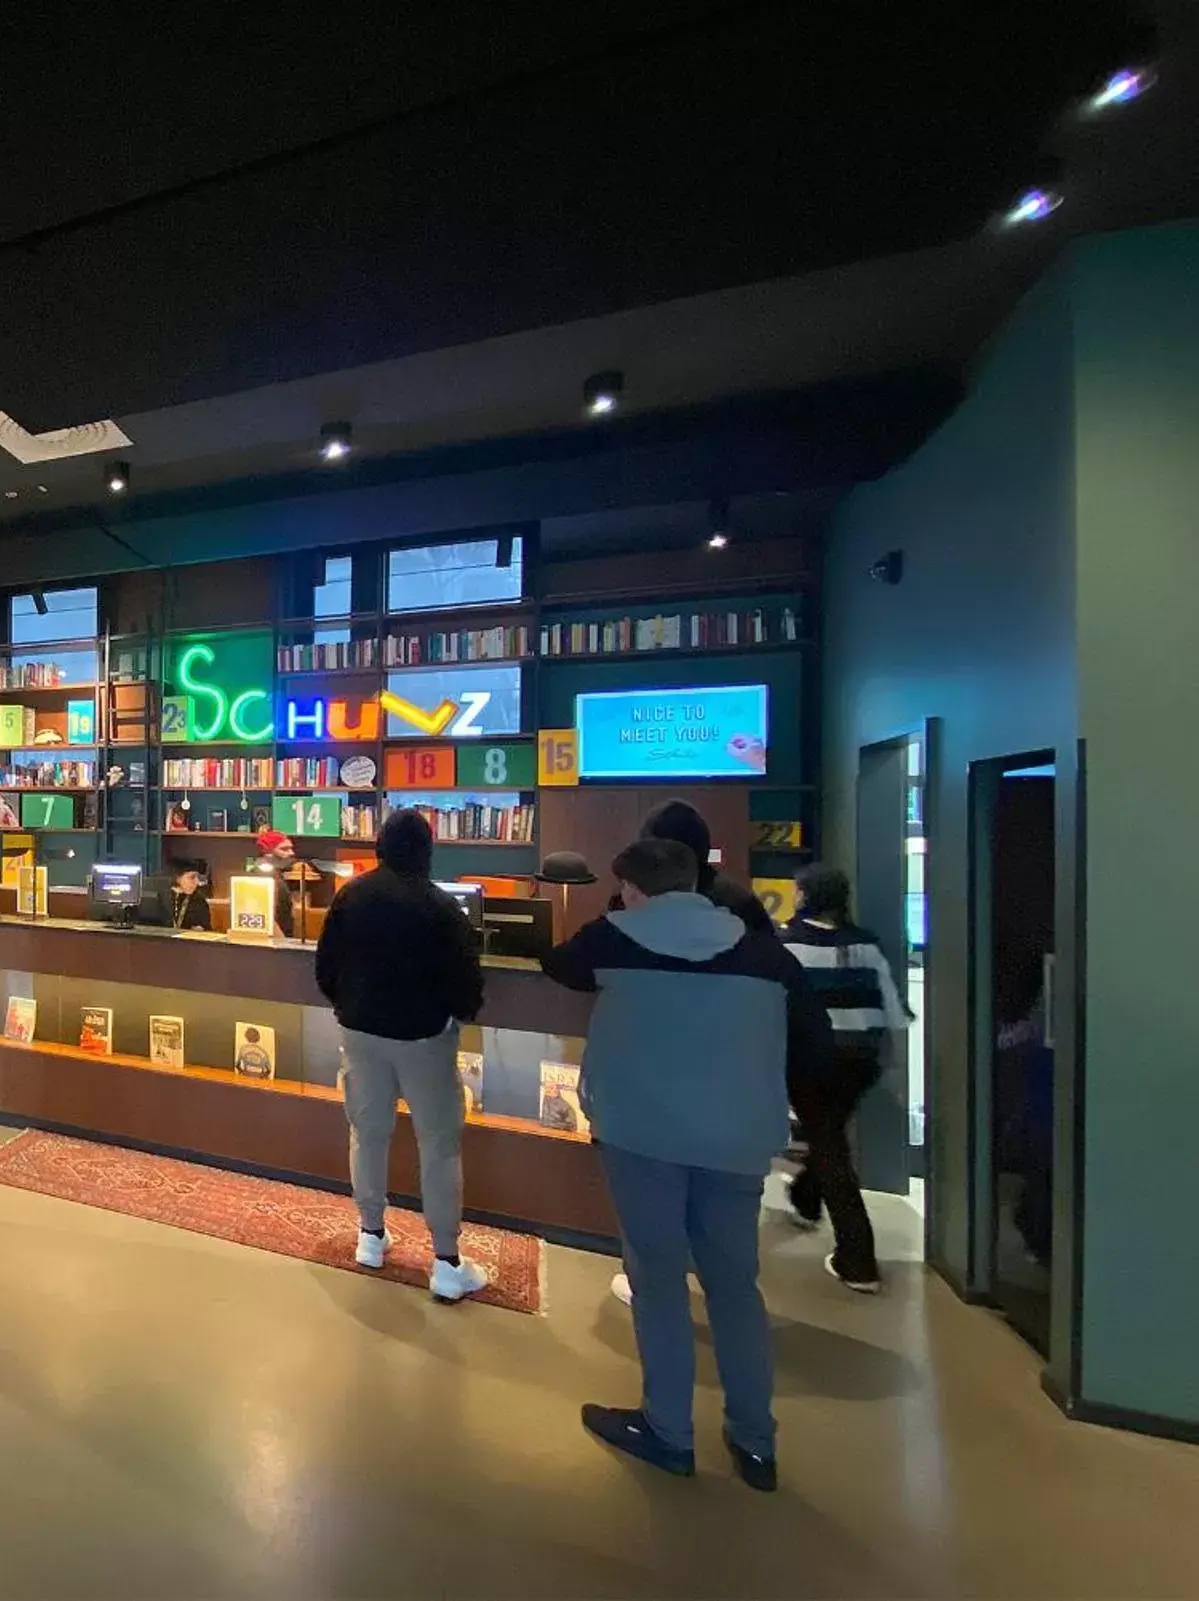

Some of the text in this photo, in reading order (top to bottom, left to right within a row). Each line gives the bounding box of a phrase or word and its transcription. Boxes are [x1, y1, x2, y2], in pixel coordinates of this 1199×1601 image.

[5, 712, 14, 729] 5
[632, 703, 705, 721] NICE TO
[619, 723, 720, 743] MEET YOU!
[404, 750, 436, 784] 18
[484, 747, 507, 785] 8
[541, 736, 575, 775] 15
[41, 797, 55, 827] 7
[291, 799, 323, 835] 14
[758, 822, 793, 847] 22
